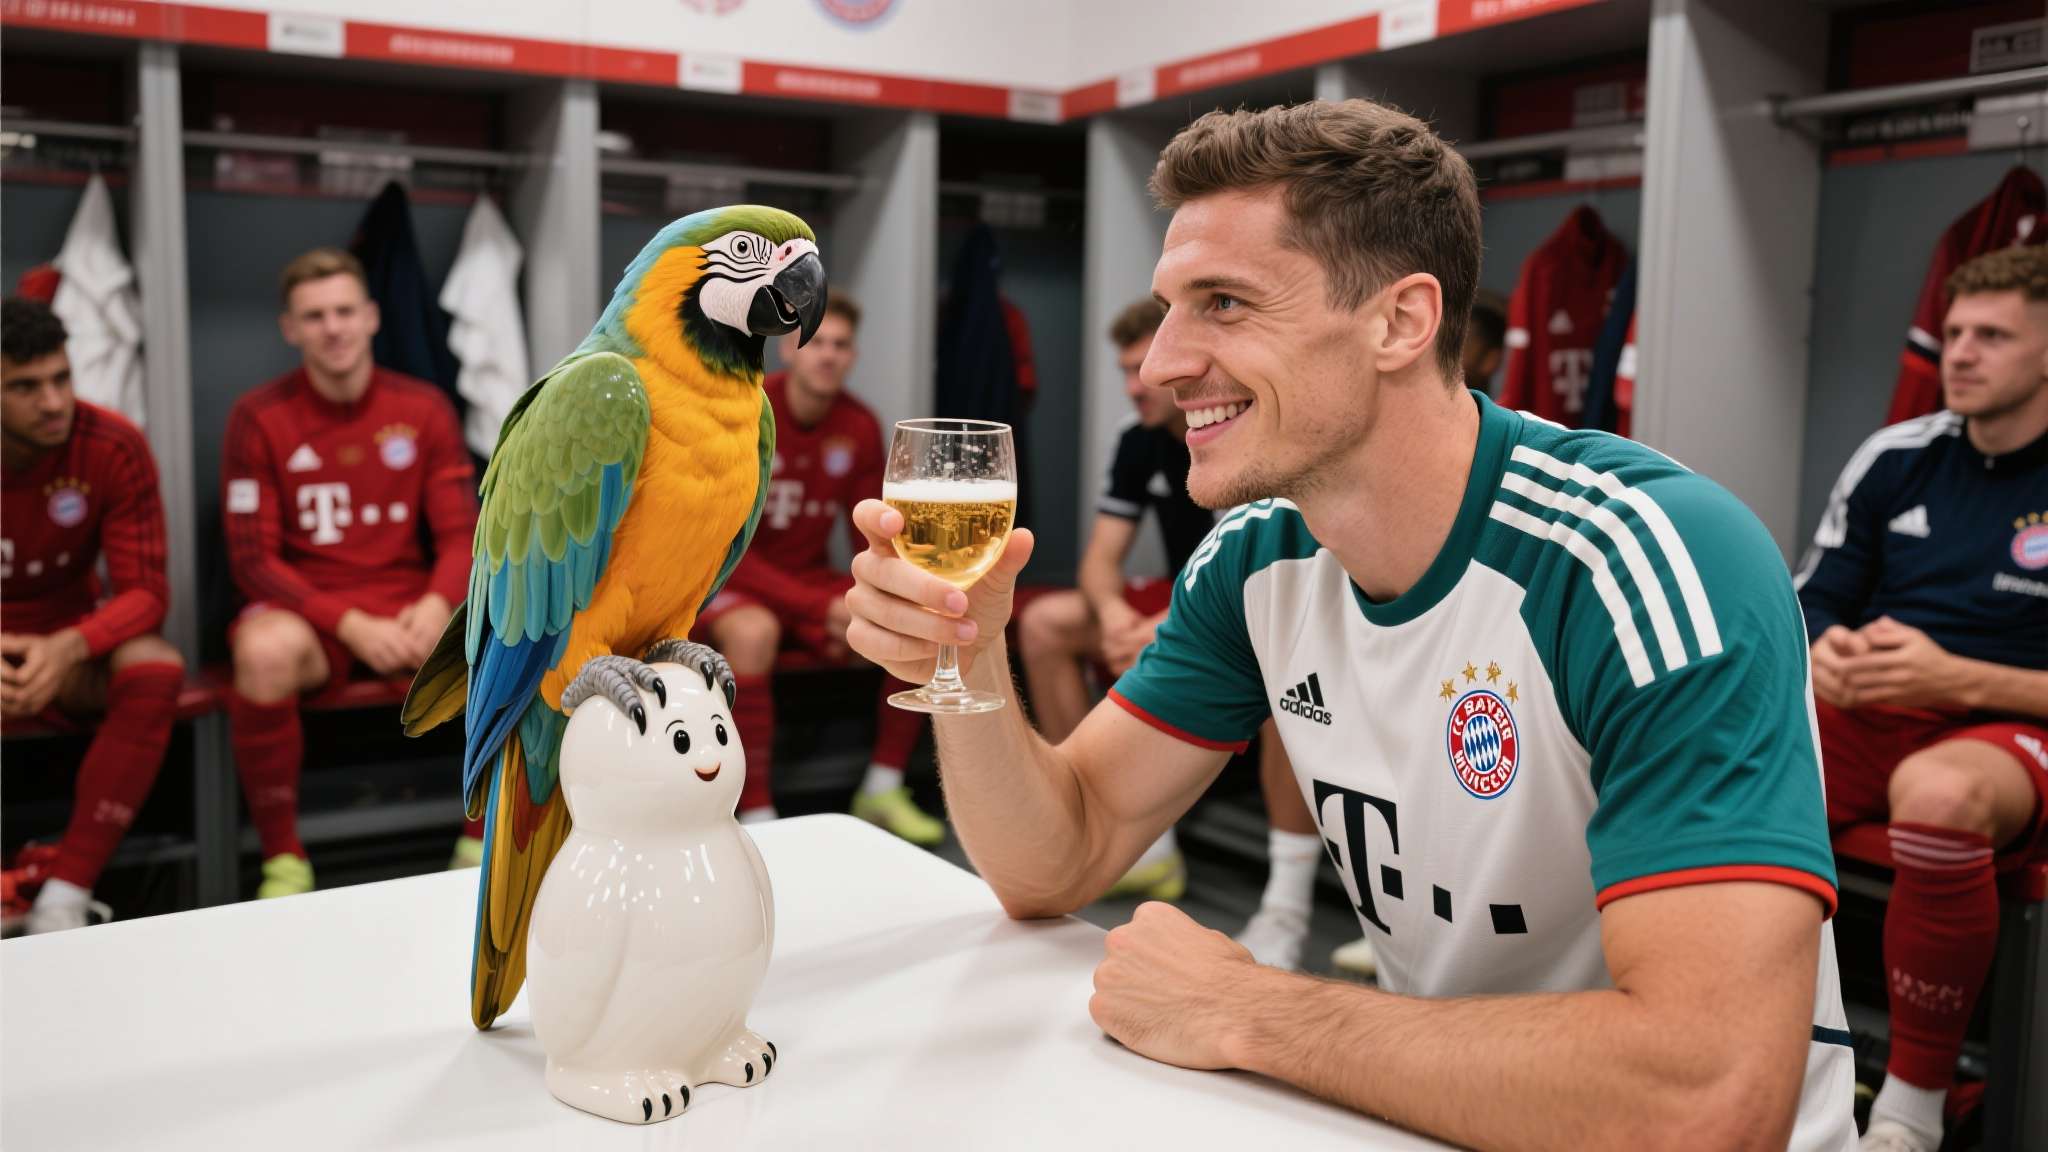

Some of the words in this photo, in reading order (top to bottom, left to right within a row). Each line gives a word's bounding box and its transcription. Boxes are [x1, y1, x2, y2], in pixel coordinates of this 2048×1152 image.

[297, 482, 352, 545] T
[1280, 698, 1332, 725] adidas
[1313, 779, 1404, 936] T
